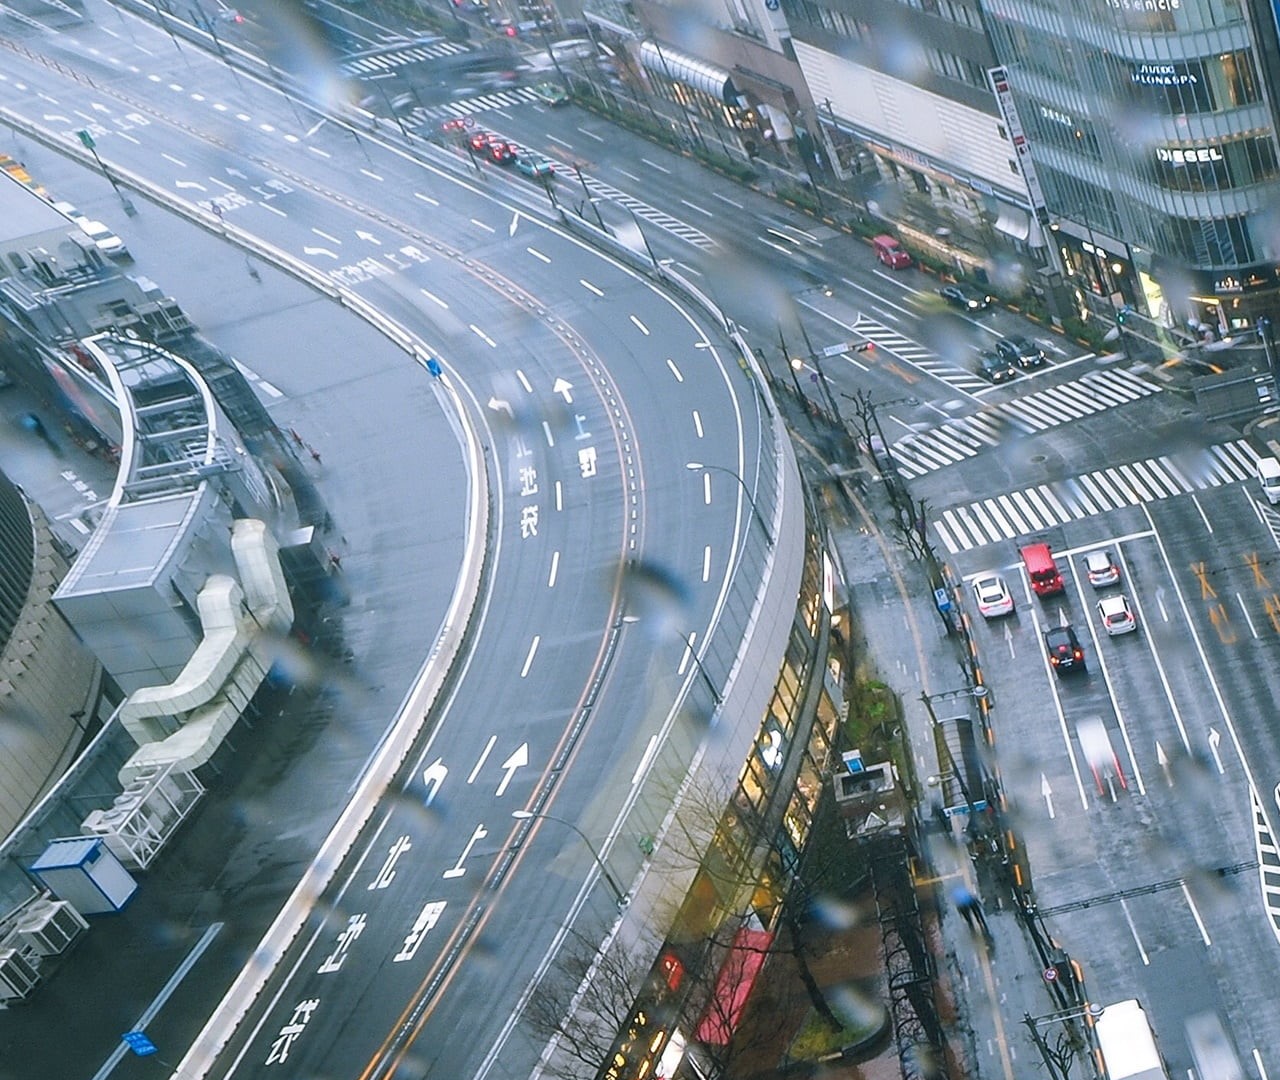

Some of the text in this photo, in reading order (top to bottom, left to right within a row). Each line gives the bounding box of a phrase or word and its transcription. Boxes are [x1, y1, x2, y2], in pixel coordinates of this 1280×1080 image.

[1155, 148, 1223, 163] DIESEL
[574, 413, 598, 480] 上野
[393, 822, 488, 964] 上野
[265, 835, 411, 1066] 北池袋
